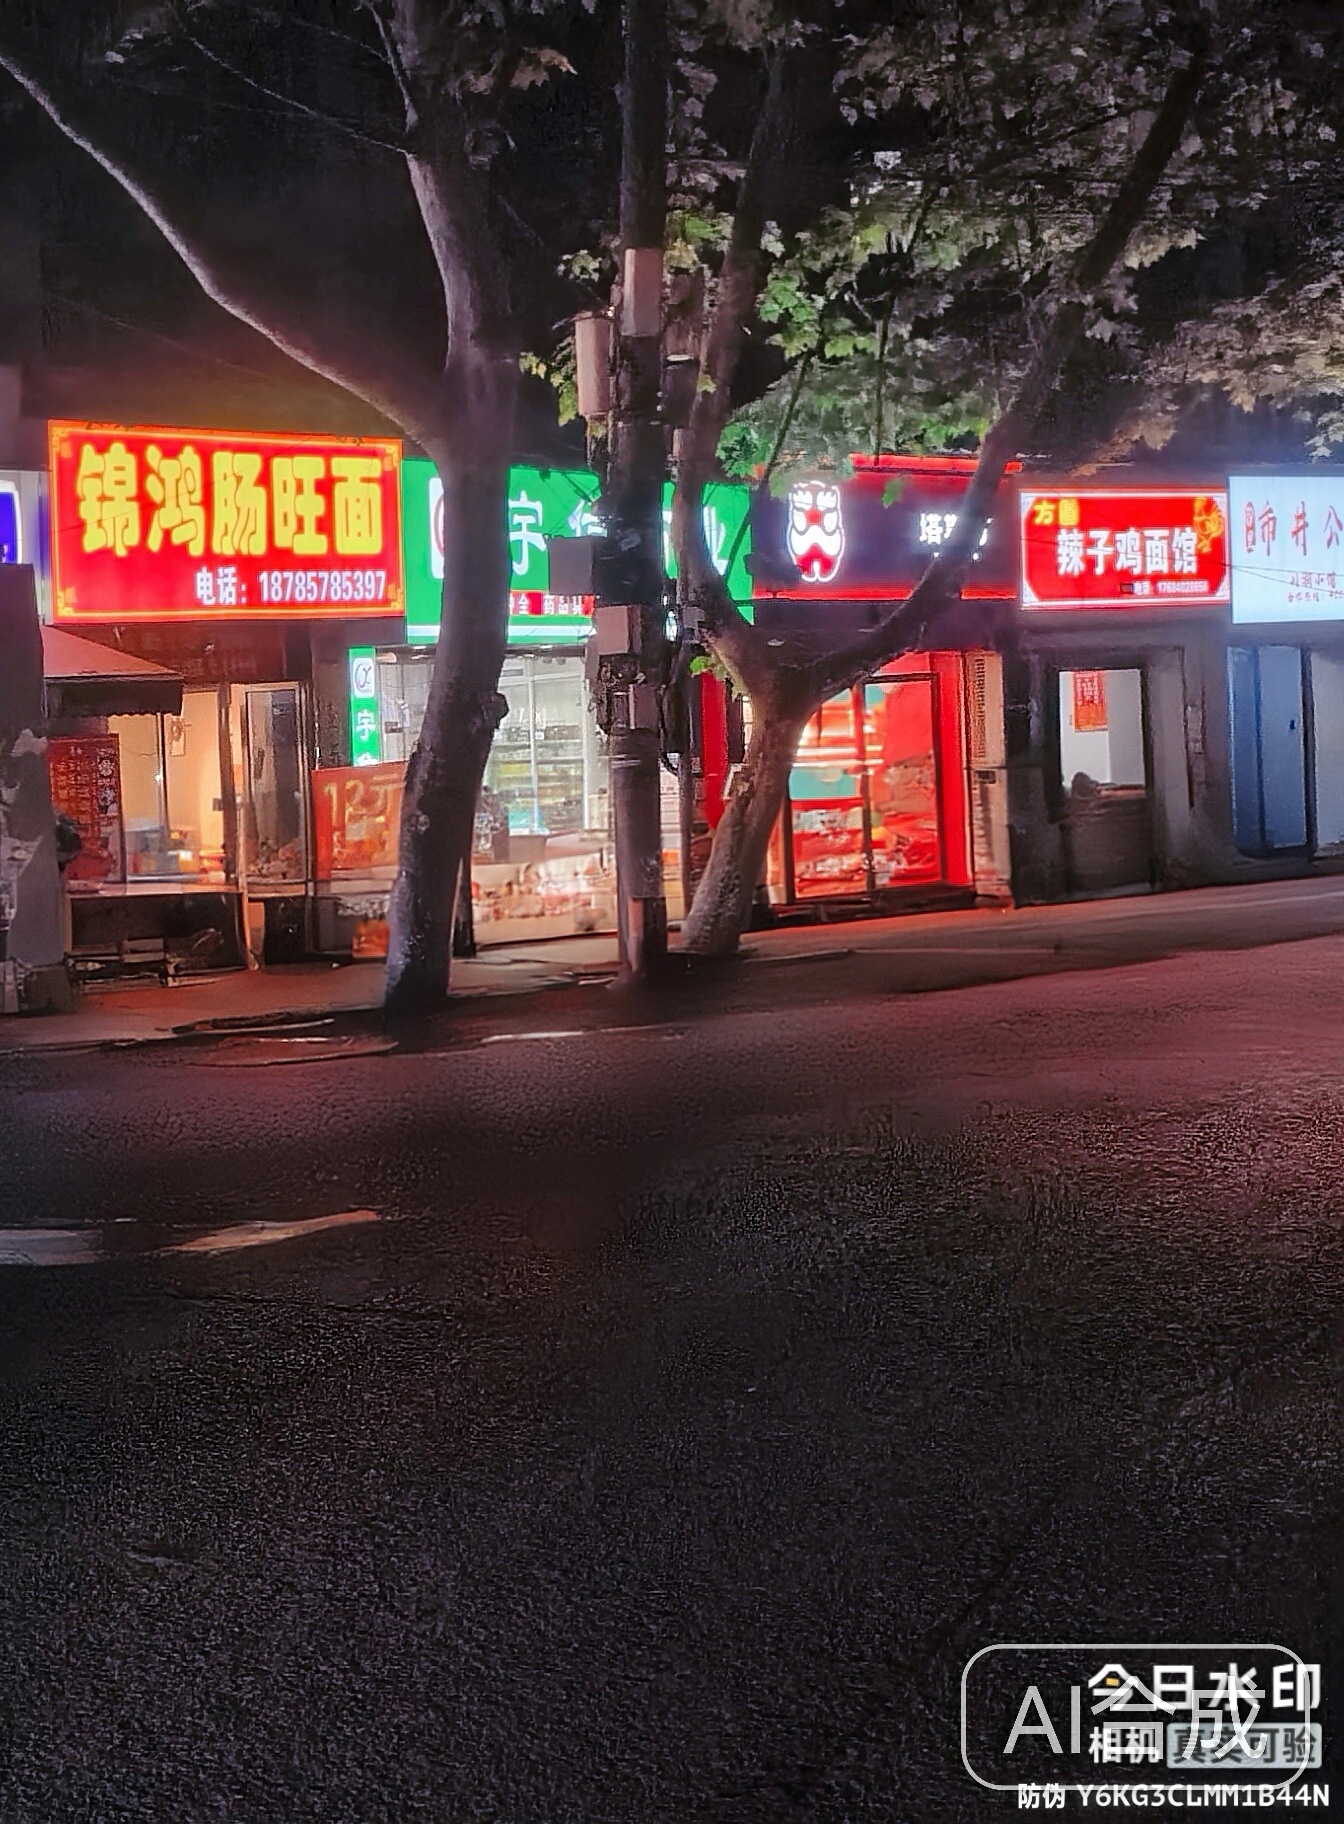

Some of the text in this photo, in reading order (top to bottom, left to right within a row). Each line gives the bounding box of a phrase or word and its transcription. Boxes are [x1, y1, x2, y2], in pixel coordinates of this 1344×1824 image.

[76, 442, 383, 557] 锦鸿肠旺面
[1057, 528, 1199, 576] 辣子鸡面馆
